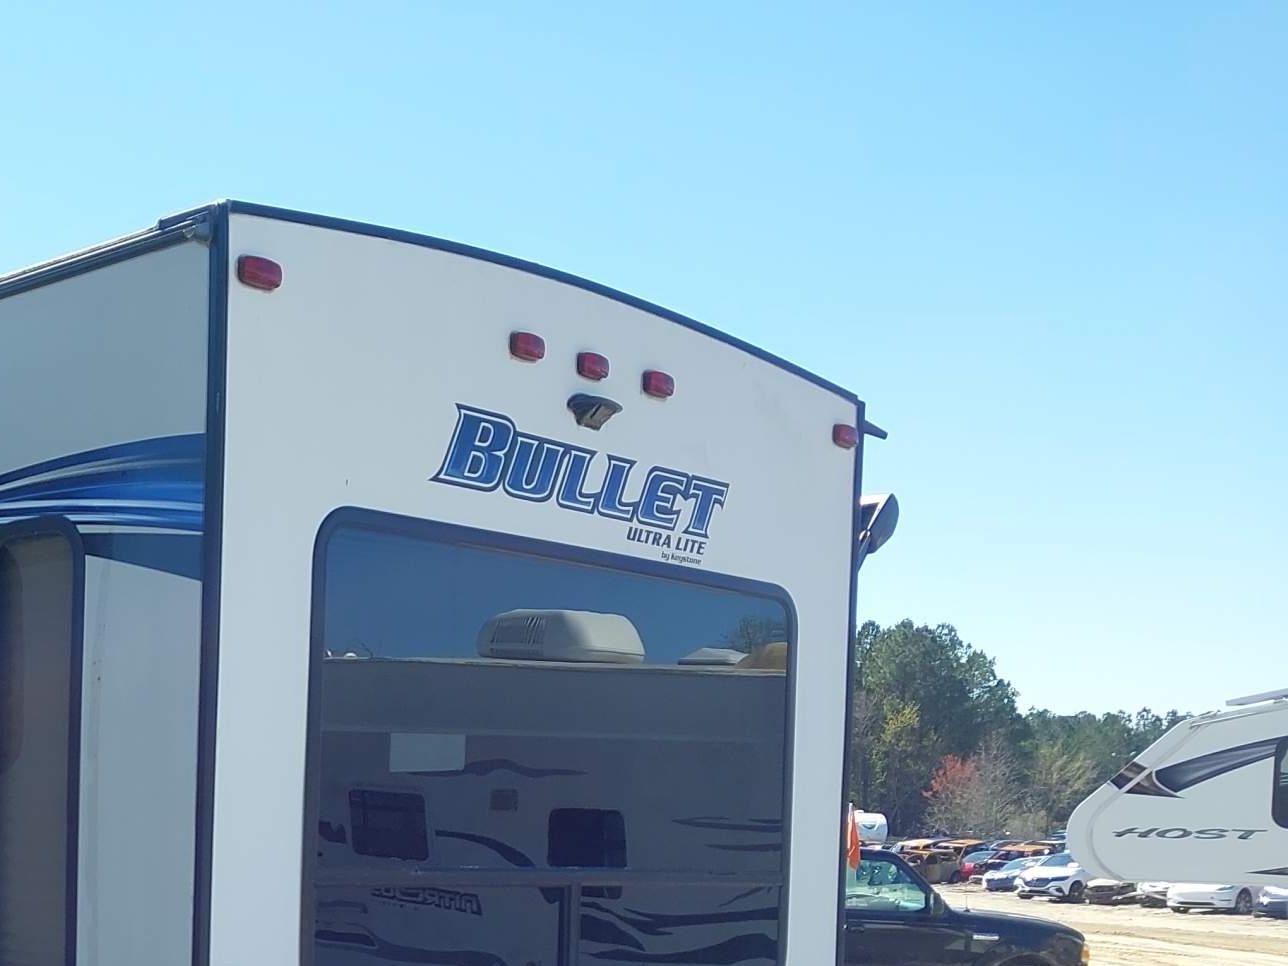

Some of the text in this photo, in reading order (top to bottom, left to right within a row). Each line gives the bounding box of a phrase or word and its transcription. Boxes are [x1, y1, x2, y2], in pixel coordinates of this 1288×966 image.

[428, 403, 730, 539] BULLET
[626, 527, 706, 556] ULTRA LITE
[661, 551, 670, 562] by
[1112, 827, 1268, 840] HOST
